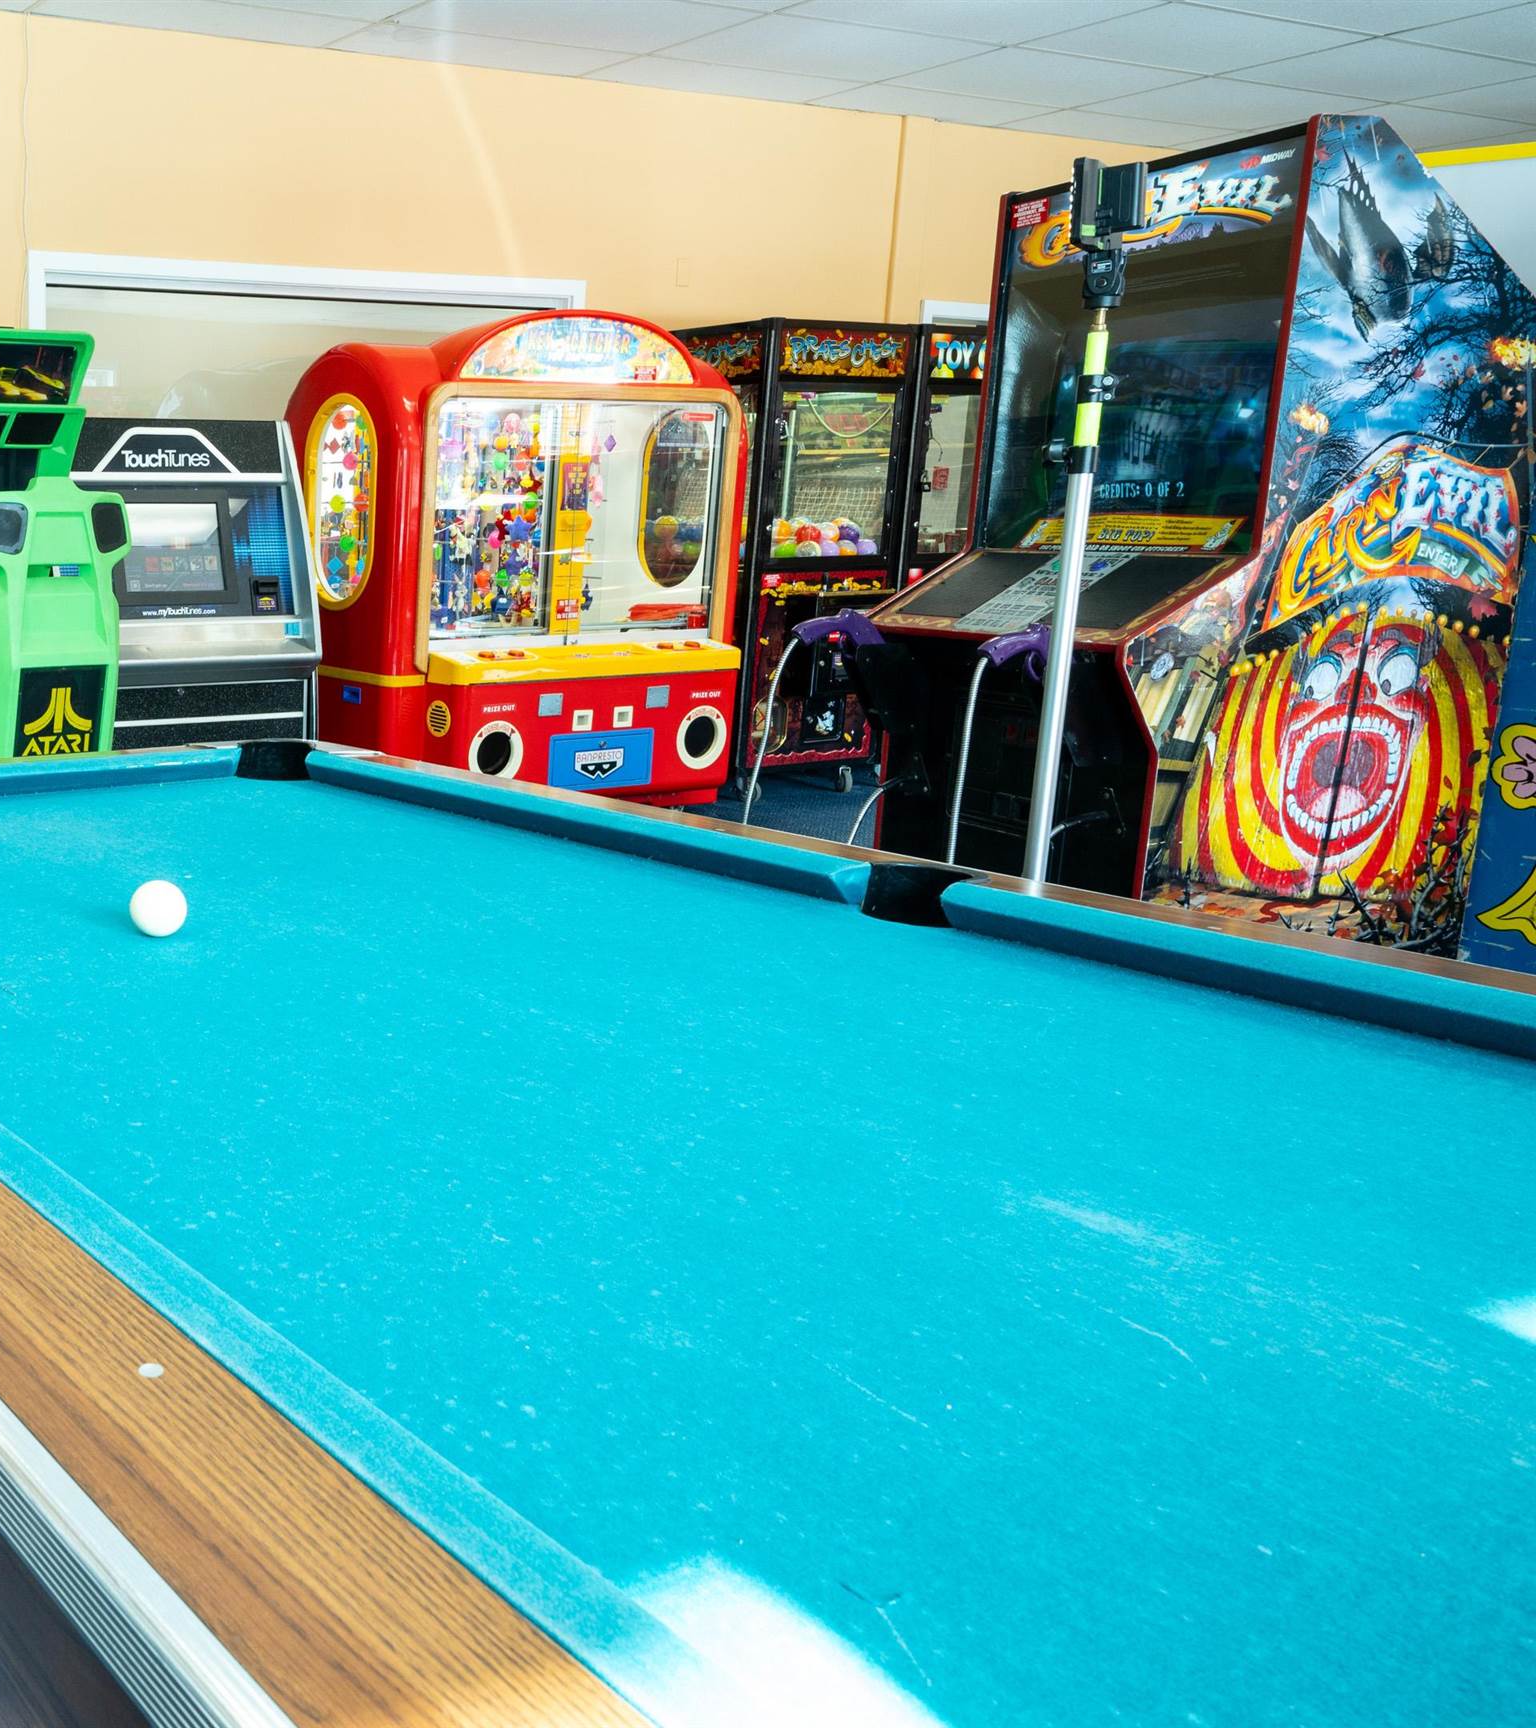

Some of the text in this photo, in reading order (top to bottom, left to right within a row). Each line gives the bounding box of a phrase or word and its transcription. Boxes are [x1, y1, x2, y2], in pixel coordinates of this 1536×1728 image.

[1260, 148, 1296, 164] MIDWAY
[936, 340, 975, 370] TOY
[121, 449, 211, 468] TouchTunes
[1099, 482, 1140, 498] CREDITS:
[1157, 481, 1170, 497] OF
[1176, 481, 1185, 497] 2
[1416, 542, 1459, 580] ENTER
[142, 606, 216, 617] www.myTouchTunes.com
[483, 705, 501, 713] PRIZE
[22, 733, 90, 757] ATARI
[576, 750, 622, 764] BANPRESTO
